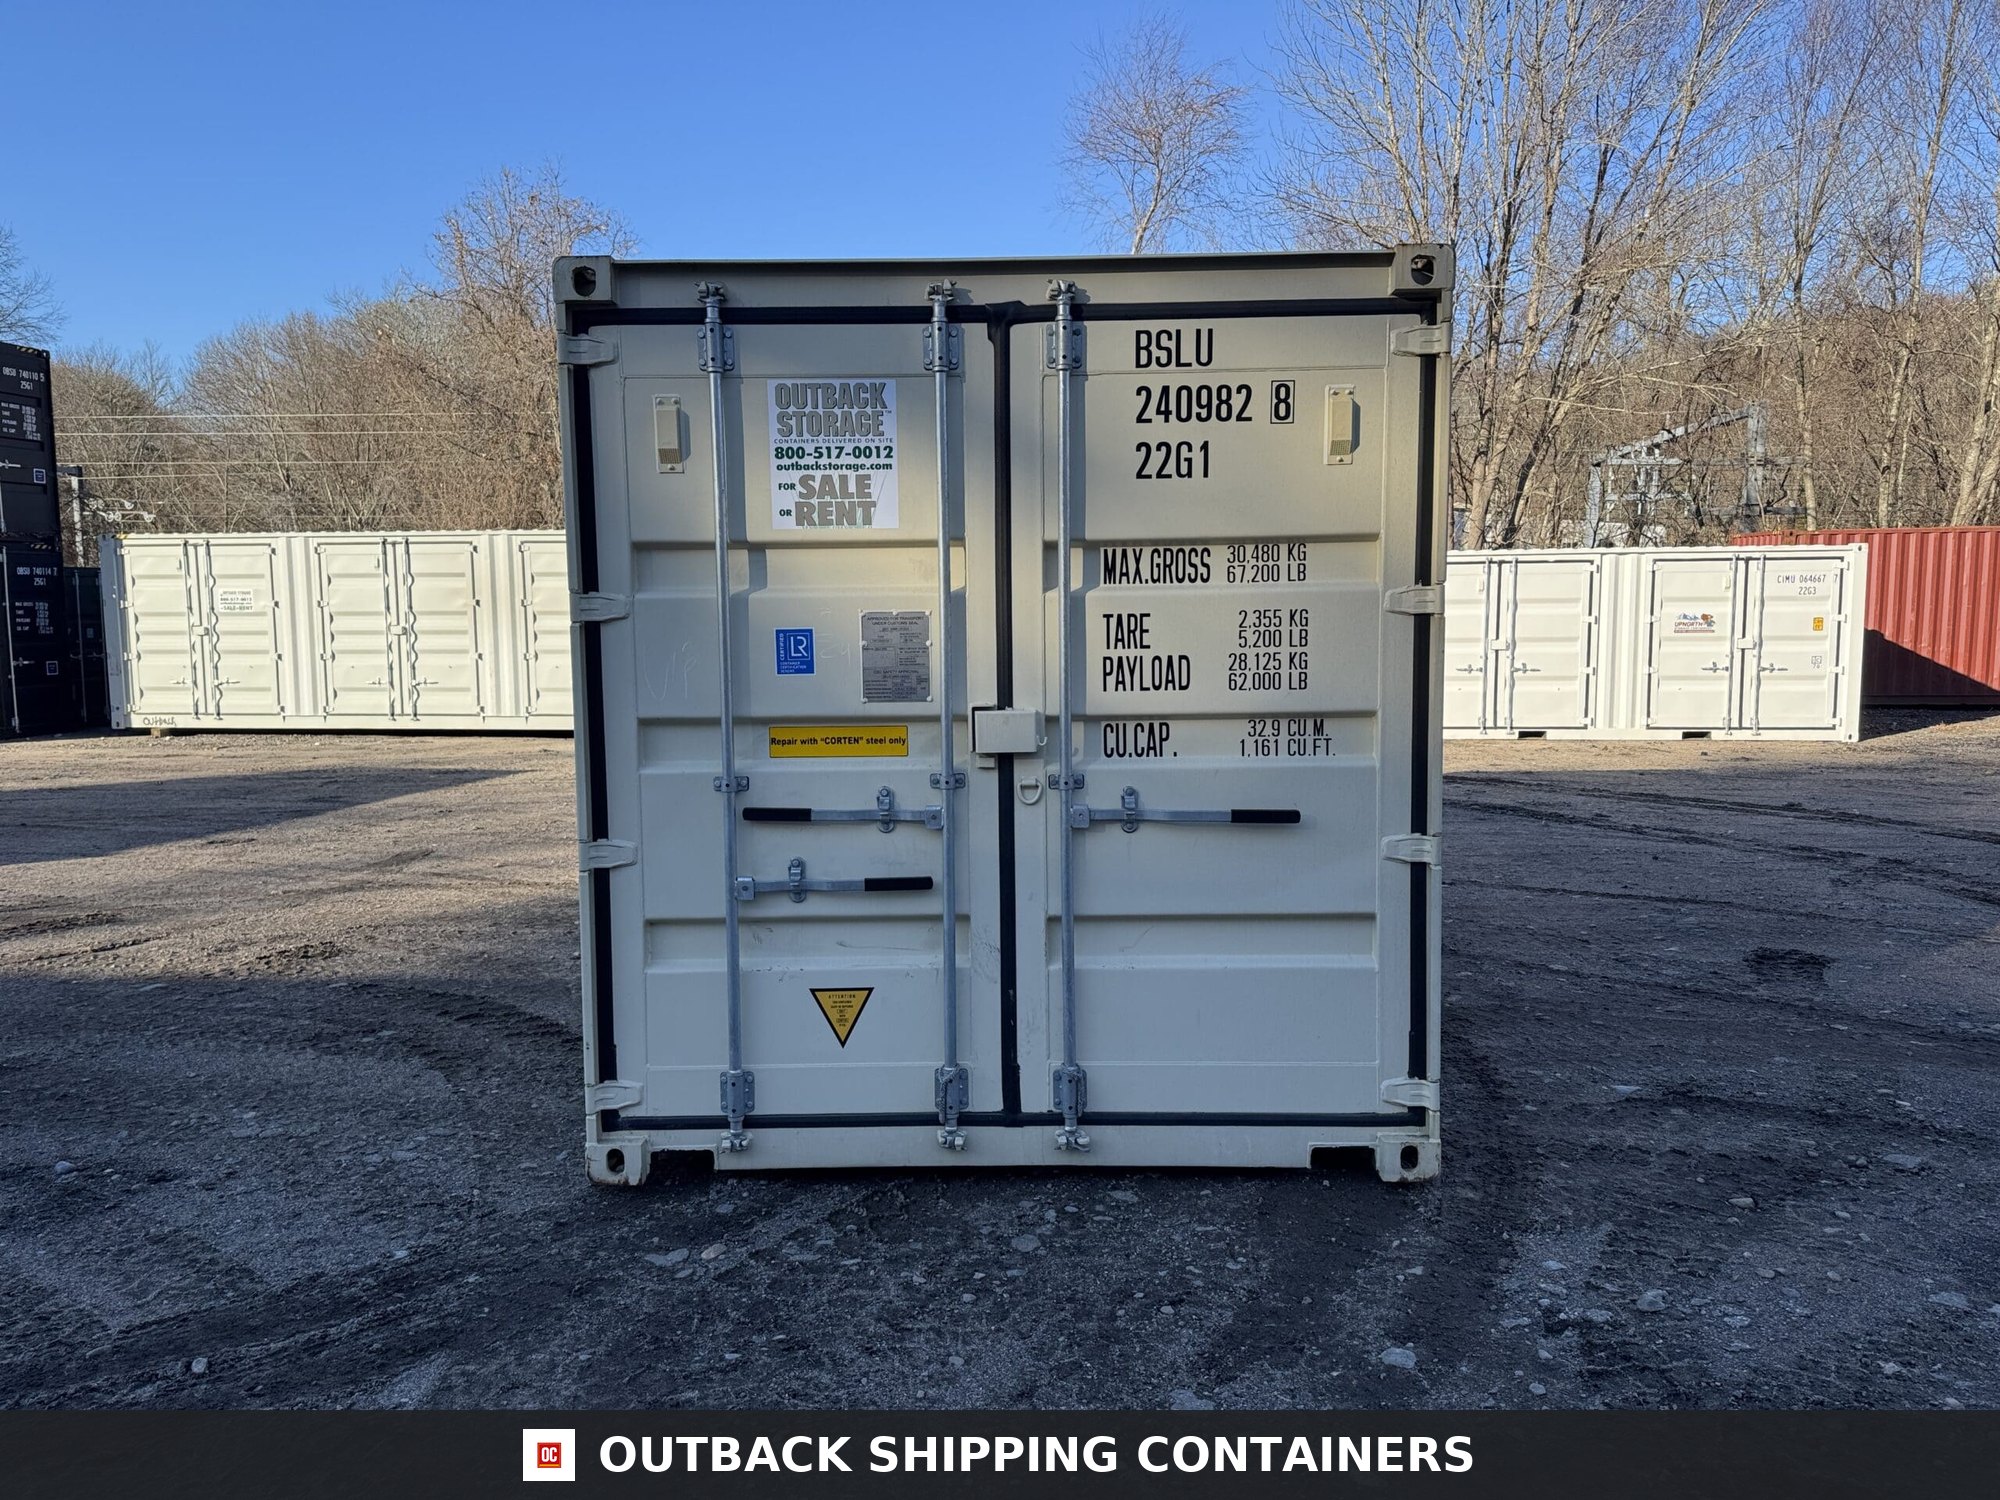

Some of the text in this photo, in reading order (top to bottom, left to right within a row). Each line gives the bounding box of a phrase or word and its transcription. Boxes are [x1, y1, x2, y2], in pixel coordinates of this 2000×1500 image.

[1135, 328, 1213, 368] BSLU
[19, 369, 38, 380] 740110
[40, 372, 44, 382] 5
[20, 381, 33, 390] 25G1
[774, 383, 888, 410] OUTBACK
[1136, 383, 1292, 423] 240982 8
[774, 446, 894, 459] 800-517-0012
[1136, 440, 1209, 479] 22G1
[776, 461, 892, 472] outbackstorage.com
[798, 474, 872, 500] SALE
[795, 501, 876, 526] RENT
[1103, 543, 1307, 584] MAX.GROSS 30,480 KG
[1227, 563, 1306, 584] 67,200 LB
[1777, 574, 1838, 583] CIMU 064667 7
[1798, 586, 1816, 595] 22G3
[1102, 608, 1309, 650] TARE 2,355 KG
[1238, 629, 1308, 649] 5,200 LB
[1102, 652, 1308, 692] PAYLOAD 28,125 KG
[1228, 672, 1308, 692] 62,000 LB
[1248, 720, 1280, 737] 32.9
[1288, 719, 1328, 737] CU.M.
[771, 738, 798, 747] Repair
[866, 736, 886, 744] steel
[889, 736, 906, 746] only
[1240, 738, 1336, 758] 1,161 CU.FT.
